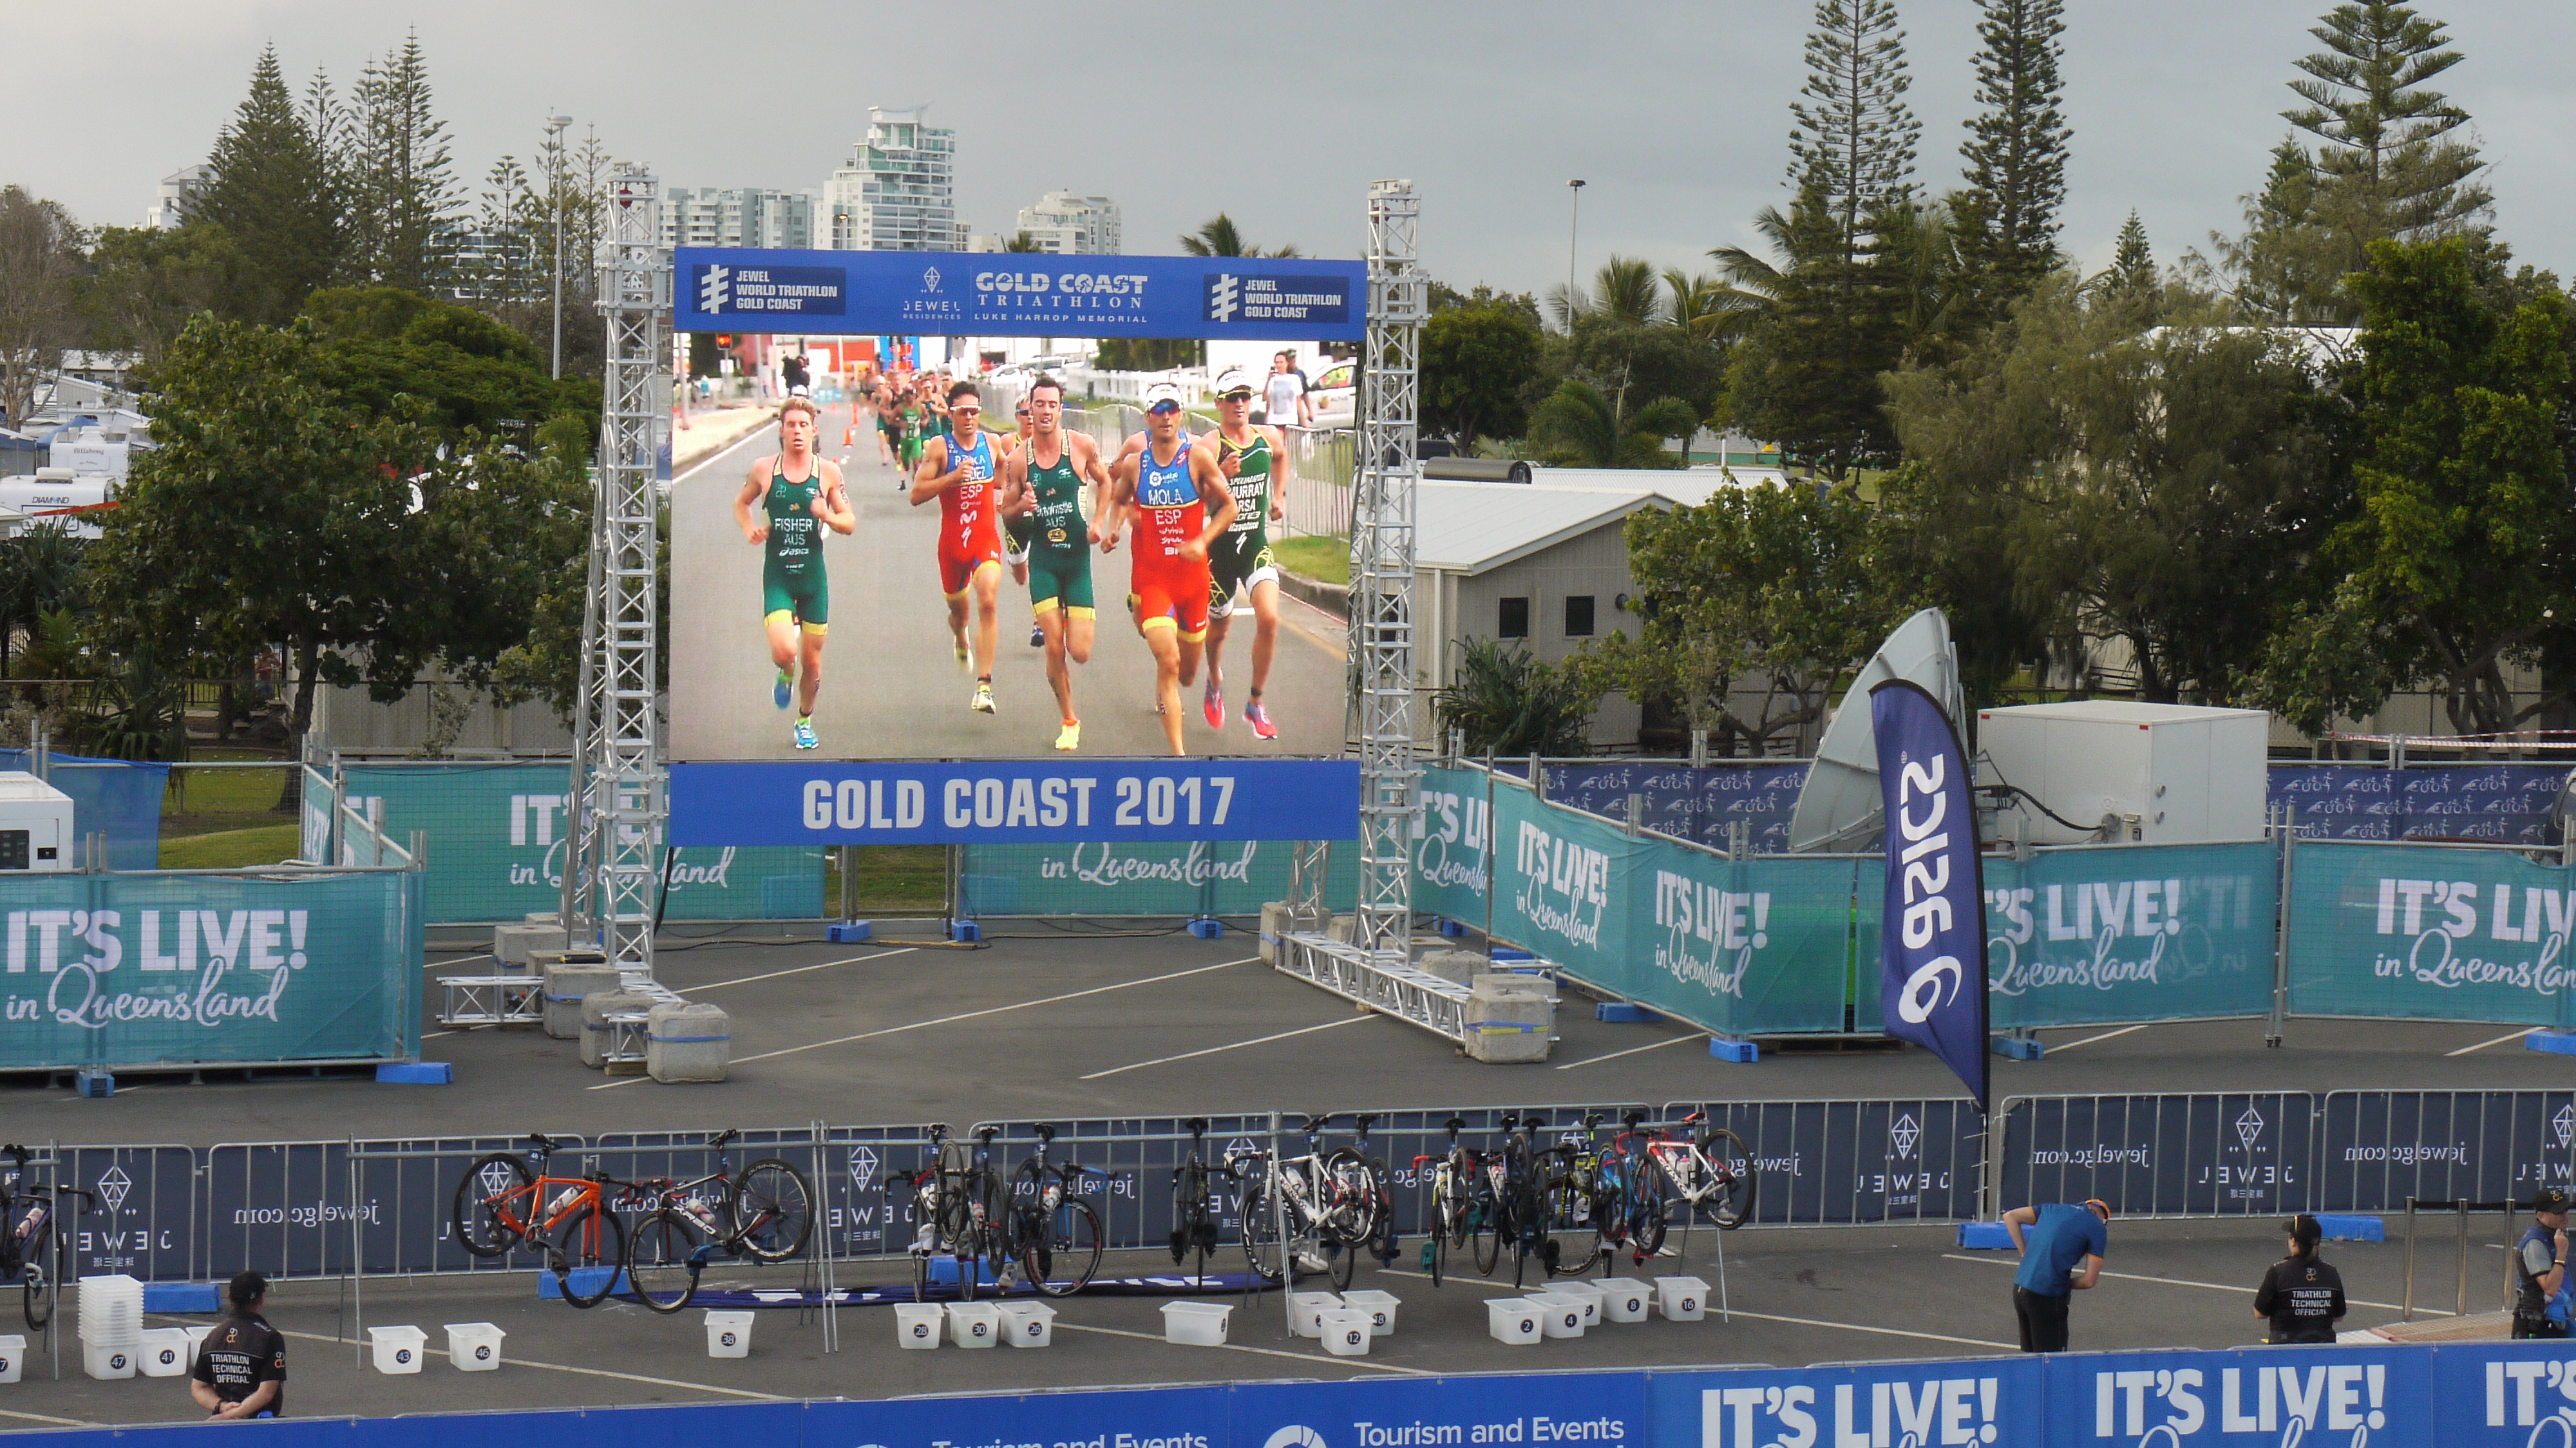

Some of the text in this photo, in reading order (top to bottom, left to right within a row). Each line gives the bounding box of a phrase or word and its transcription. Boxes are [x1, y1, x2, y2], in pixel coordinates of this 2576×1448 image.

[737, 271, 770, 283] JEWEL
[976, 272, 1148, 294] GOLD COAST
[737, 284, 837, 298] WORLD TRIATHLON
[1245, 280, 1277, 291] JEWEL
[737, 298, 802, 310] GOLD COAST
[904, 300, 960, 312] JEWEL
[978, 294, 1141, 309] TRIATHLON
[1245, 293, 1341, 306] WORLD TRIATHLON
[1245, 306, 1308, 319] GOLD COAST
[961, 484, 983, 500] ESP
[1148, 488, 1184, 505] MOLA
[1238, 499, 1256, 513] RSA
[1155, 509, 1182, 525] ESP
[775, 518, 813, 533] FISHER
[784, 533, 806, 546] AUS
[803, 776, 1235, 829] GOLD COAST 2017
[1042, 841, 1257, 886] in Queensland
[1518, 820, 1609, 908] IT'S LIVE!
[511, 864, 537, 885] in
[1517, 872, 1601, 951] in Queensland
[1656, 870, 1770, 949] IT'S LIVE!
[2047, 879, 2180, 941] LIVE!
[2377, 879, 2477, 938] IT'S
[7, 910, 308, 973] IT'S LIVE!
[1656, 922, 1752, 999] in Queensland
[1987, 924, 2166, 996] Queensland
[2375, 953, 2403, 978] in
[6, 955, 289, 1029] in Queensland
[2292, 1290, 2331, 1299] TRIATHLON
[1630, 1300, 1636, 1310] 8
[1683, 1300, 1694, 1310] 16
[2291, 1299, 2331, 1308] TECHNICAL
[1524, 1322, 1530, 1331] 2
[1567, 1317, 1573, 1326] 4
[915, 1326, 927, 1336] 28
[973, 1326, 985, 1334] 30
[1029, 1324, 1041, 1334] 26
[722, 1334, 735, 1344] 38
[1349, 1333, 1359, 1343] 12
[161, 1352, 173, 1362] 41
[211, 1353, 249, 1365] TRIATHLON
[397, 1351, 410, 1361] 43
[477, 1348, 489, 1358] 46
[111, 1357, 124, 1367] 47
[213, 1364, 253, 1374] TECHNICAL
[216, 1375, 250, 1384] OFFICIAL
[2096, 1365, 2385, 1437] IT'S LIVE!
[1702, 1378, 1998, 1448] IT'S LIVE!
[1354, 1416, 1624, 1447] Tourism and Events
